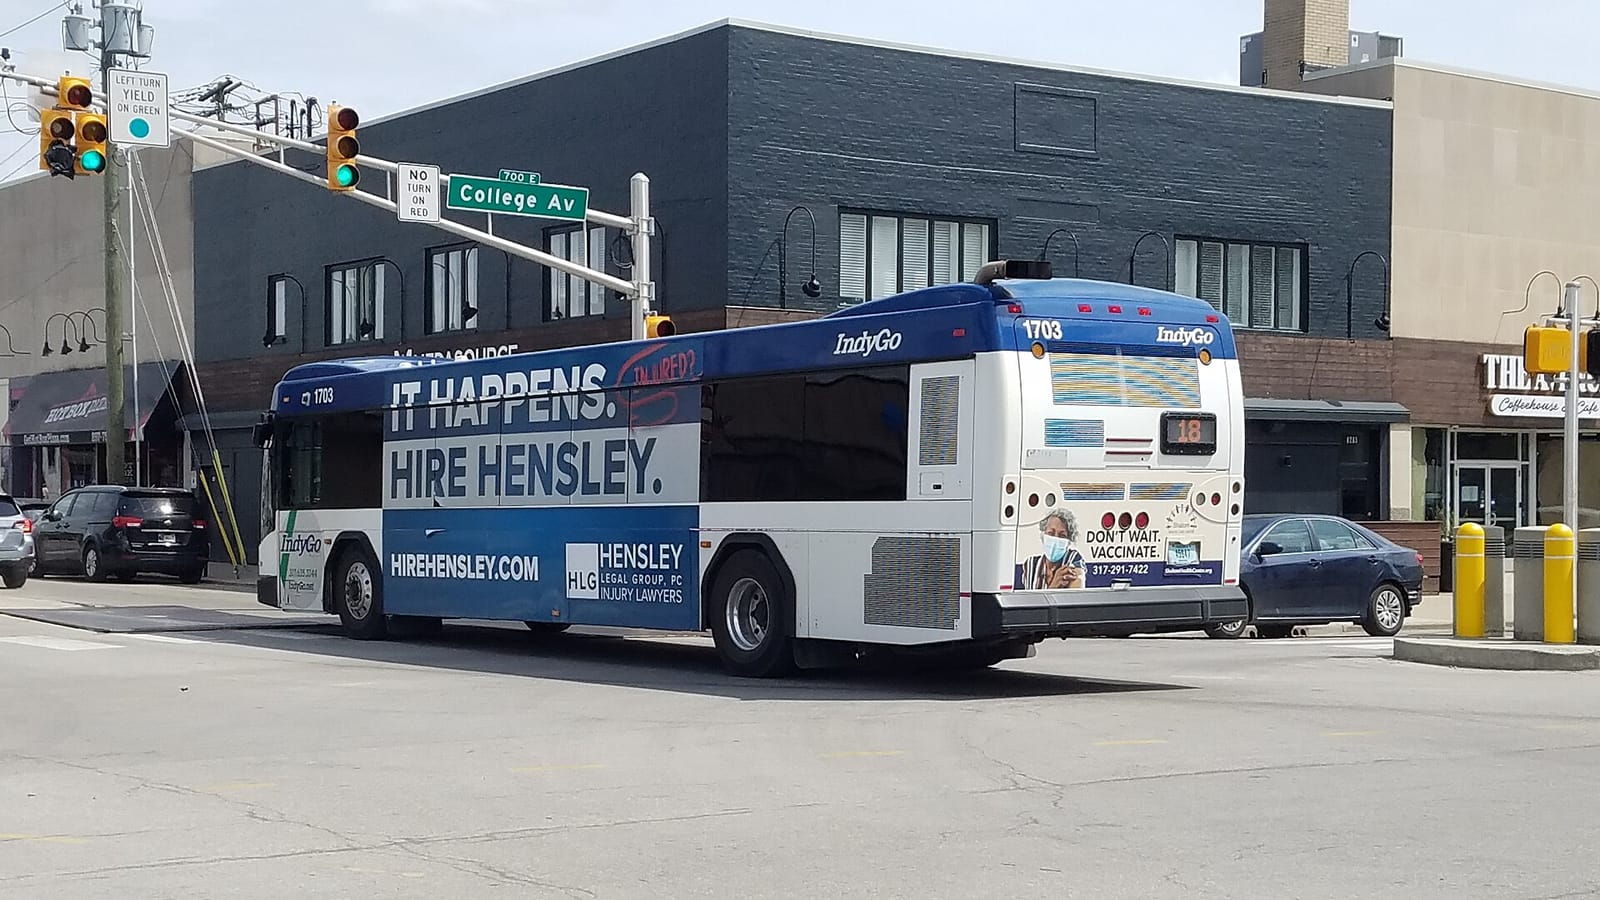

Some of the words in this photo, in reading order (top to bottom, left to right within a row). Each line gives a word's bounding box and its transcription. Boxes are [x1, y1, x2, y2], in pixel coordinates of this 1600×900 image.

[116, 75, 135, 86] LEFT
[140, 78, 161, 88] TURN
[123, 88, 155, 103] YIELD
[117, 103, 129, 113] ON
[133, 104, 161, 115] GREEN
[409, 169, 428, 181] NO
[503, 171, 525, 183] 700
[529, 174, 537, 184] E
[407, 183, 431, 193] TURN
[412, 195, 425, 206] ON
[460, 184, 537, 212] College
[547, 194, 575, 212] Av
[410, 207, 428, 218] RED
[1023, 319, 1062, 340] 1703
[1156, 326, 1214, 347] IndyGo
[833, 328, 902, 357] IndyGo
[633, 349, 696, 386] INJURED?
[1483, 353, 1532, 390] THE
[314, 387, 334, 404] 1703
[389, 381, 421, 432] IT
[429, 363, 616, 429] HAPPENS.
[1498, 397, 1558, 412] Coffeehouse
[1178, 419, 1201, 443] 18
[391, 447, 467, 499] HIRE
[478, 437, 663, 497] HENSLEY.
[1087, 530, 1125, 543] DON'T
[1129, 530, 1161, 543] WAIT.
[281, 534, 322, 557] IndyGo
[1091, 546, 1160, 558] VACCINATE.
[600, 543, 683, 569] HENSLEY
[391, 553, 539, 581] HIREHENSLEY.COM
[1093, 564, 1149, 575] 317-291-7422
[568, 571, 597, 590] HLG
[601, 572, 628, 584] LEGAL
[632, 574, 667, 586] GROUP,
[671, 575, 683, 586] PC
[601, 587, 634, 601] INJURY
[636, 588, 683, 604] LAWYERS
